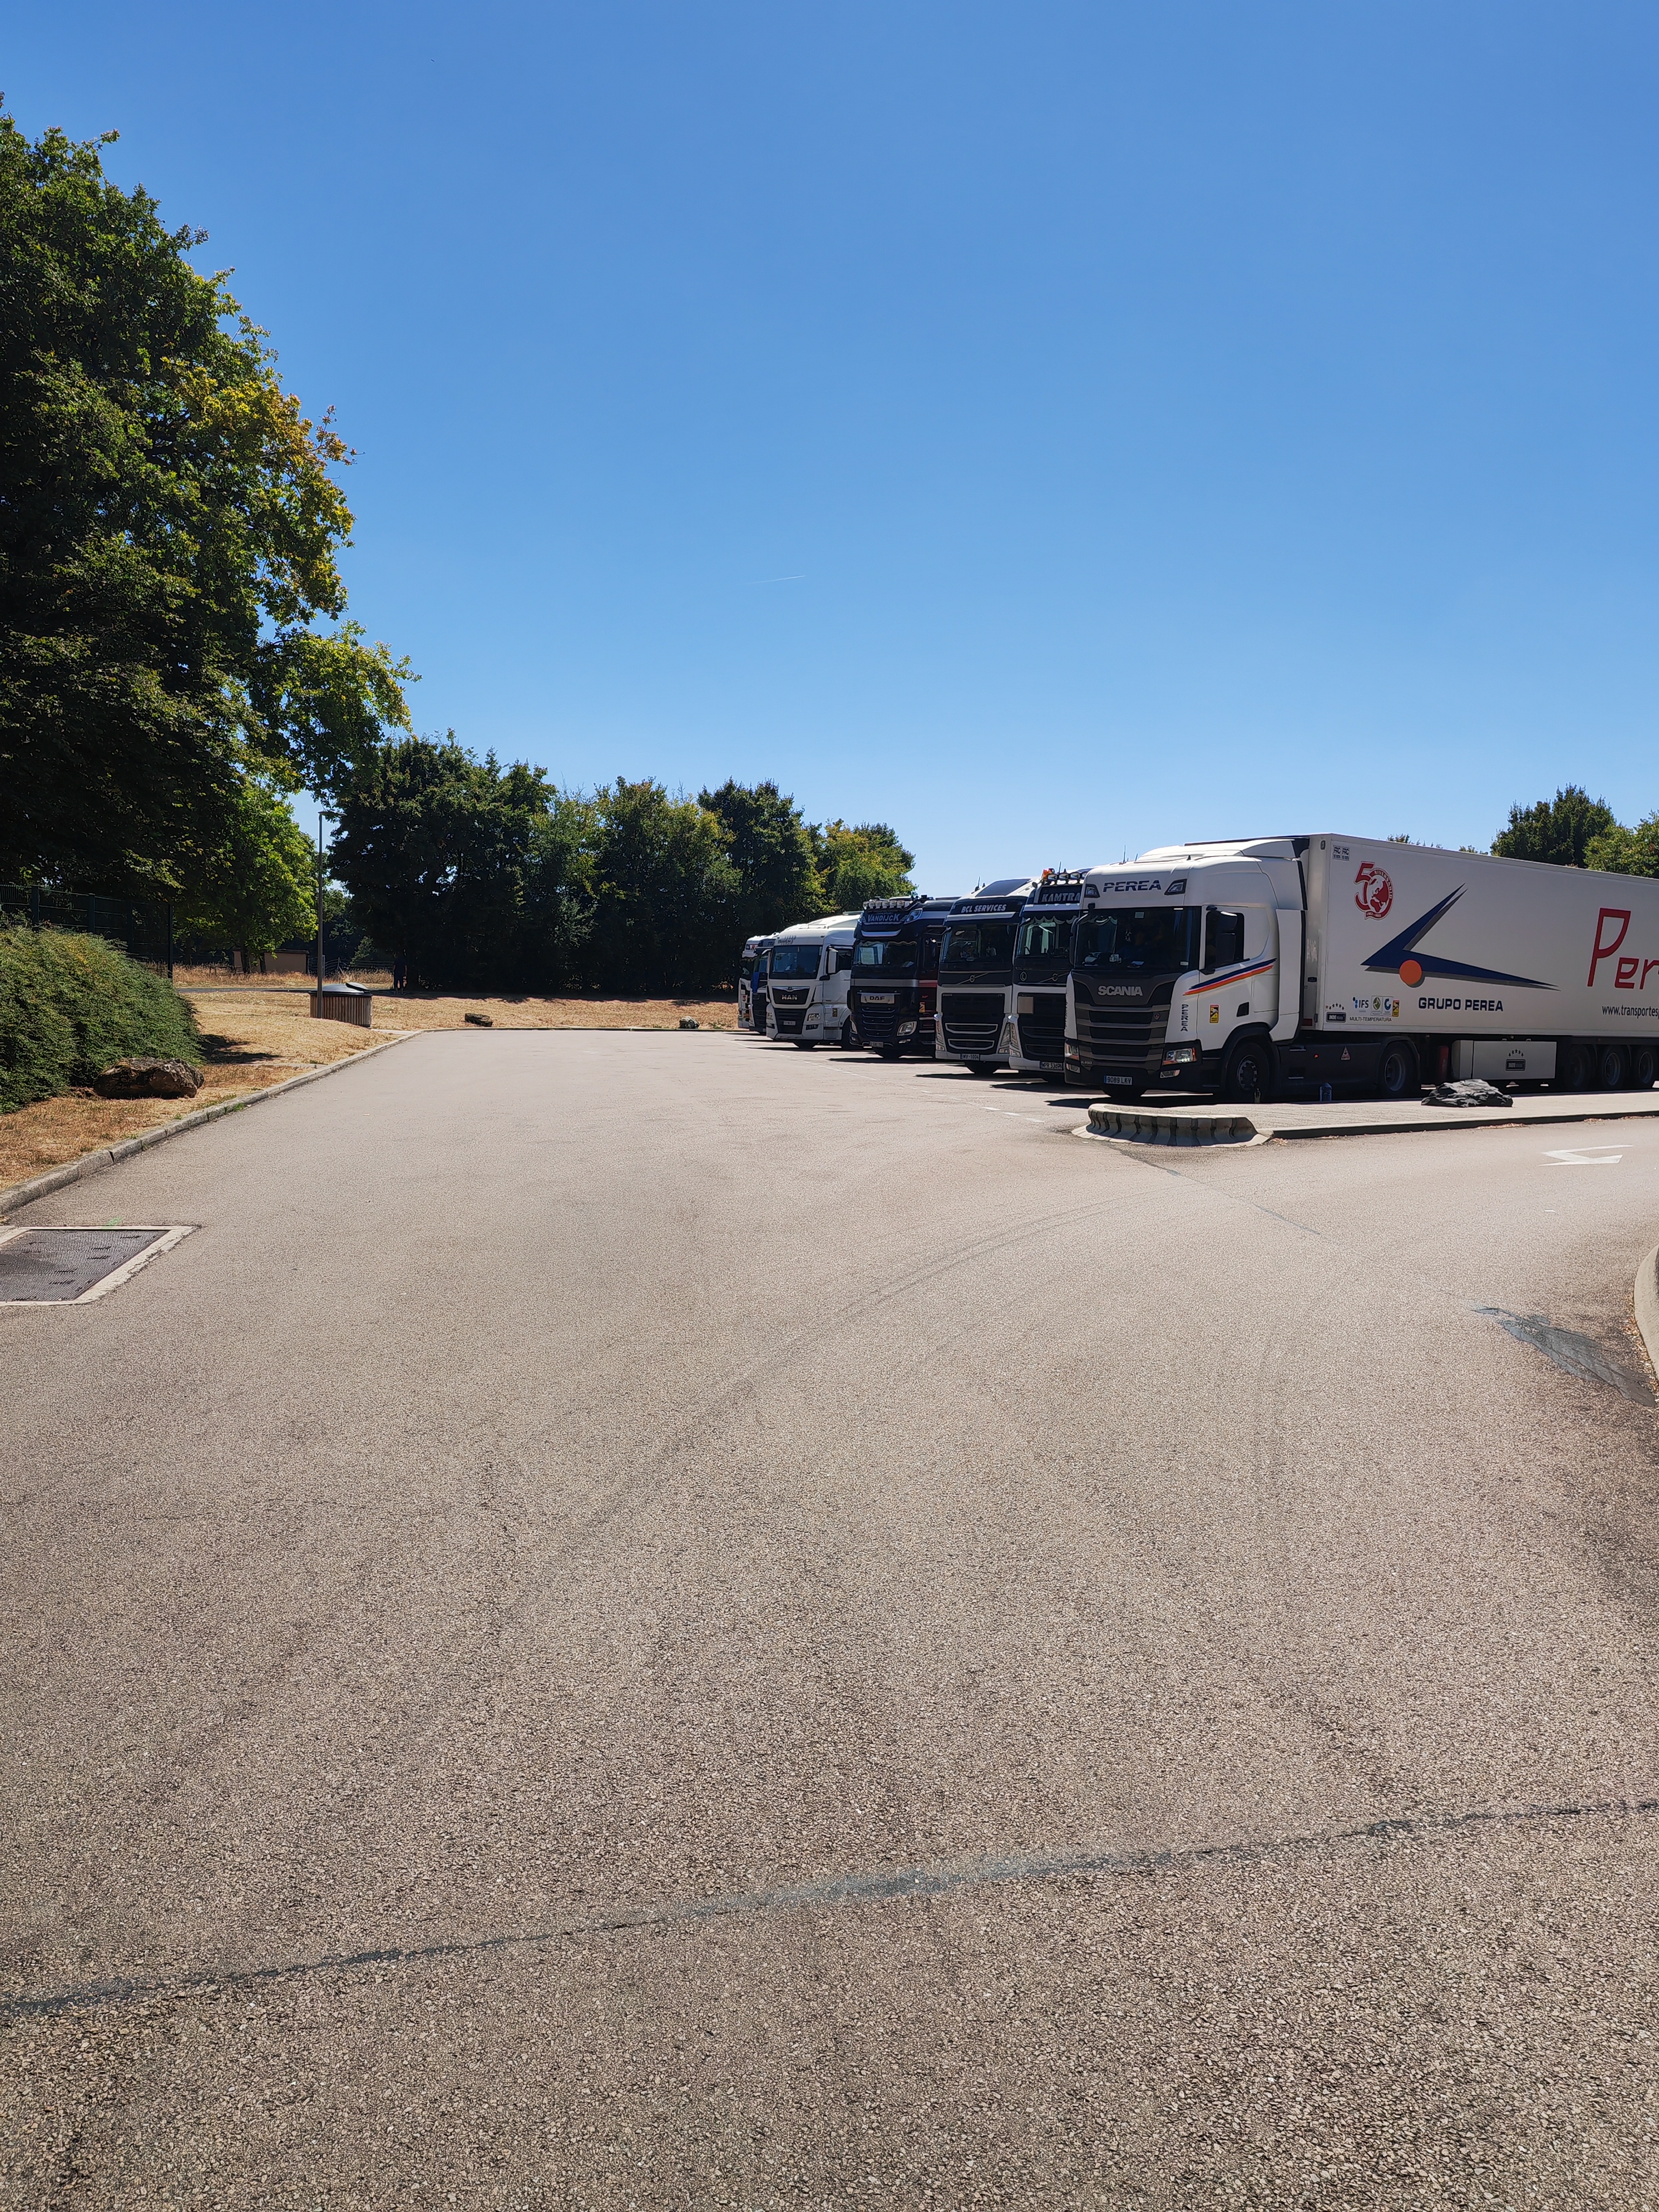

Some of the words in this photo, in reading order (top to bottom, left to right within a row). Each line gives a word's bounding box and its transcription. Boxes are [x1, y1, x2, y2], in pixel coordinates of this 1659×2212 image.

[1103, 880, 1162, 892] PEREA
[1098, 986, 1143, 996] SCANIA
[1359, 1000, 1369, 1008] IFS
[1418, 997, 1461, 1010] GRUPO
[1465, 999, 1503, 1011] PEREA
[1181, 1004, 1189, 1031] PEREA
